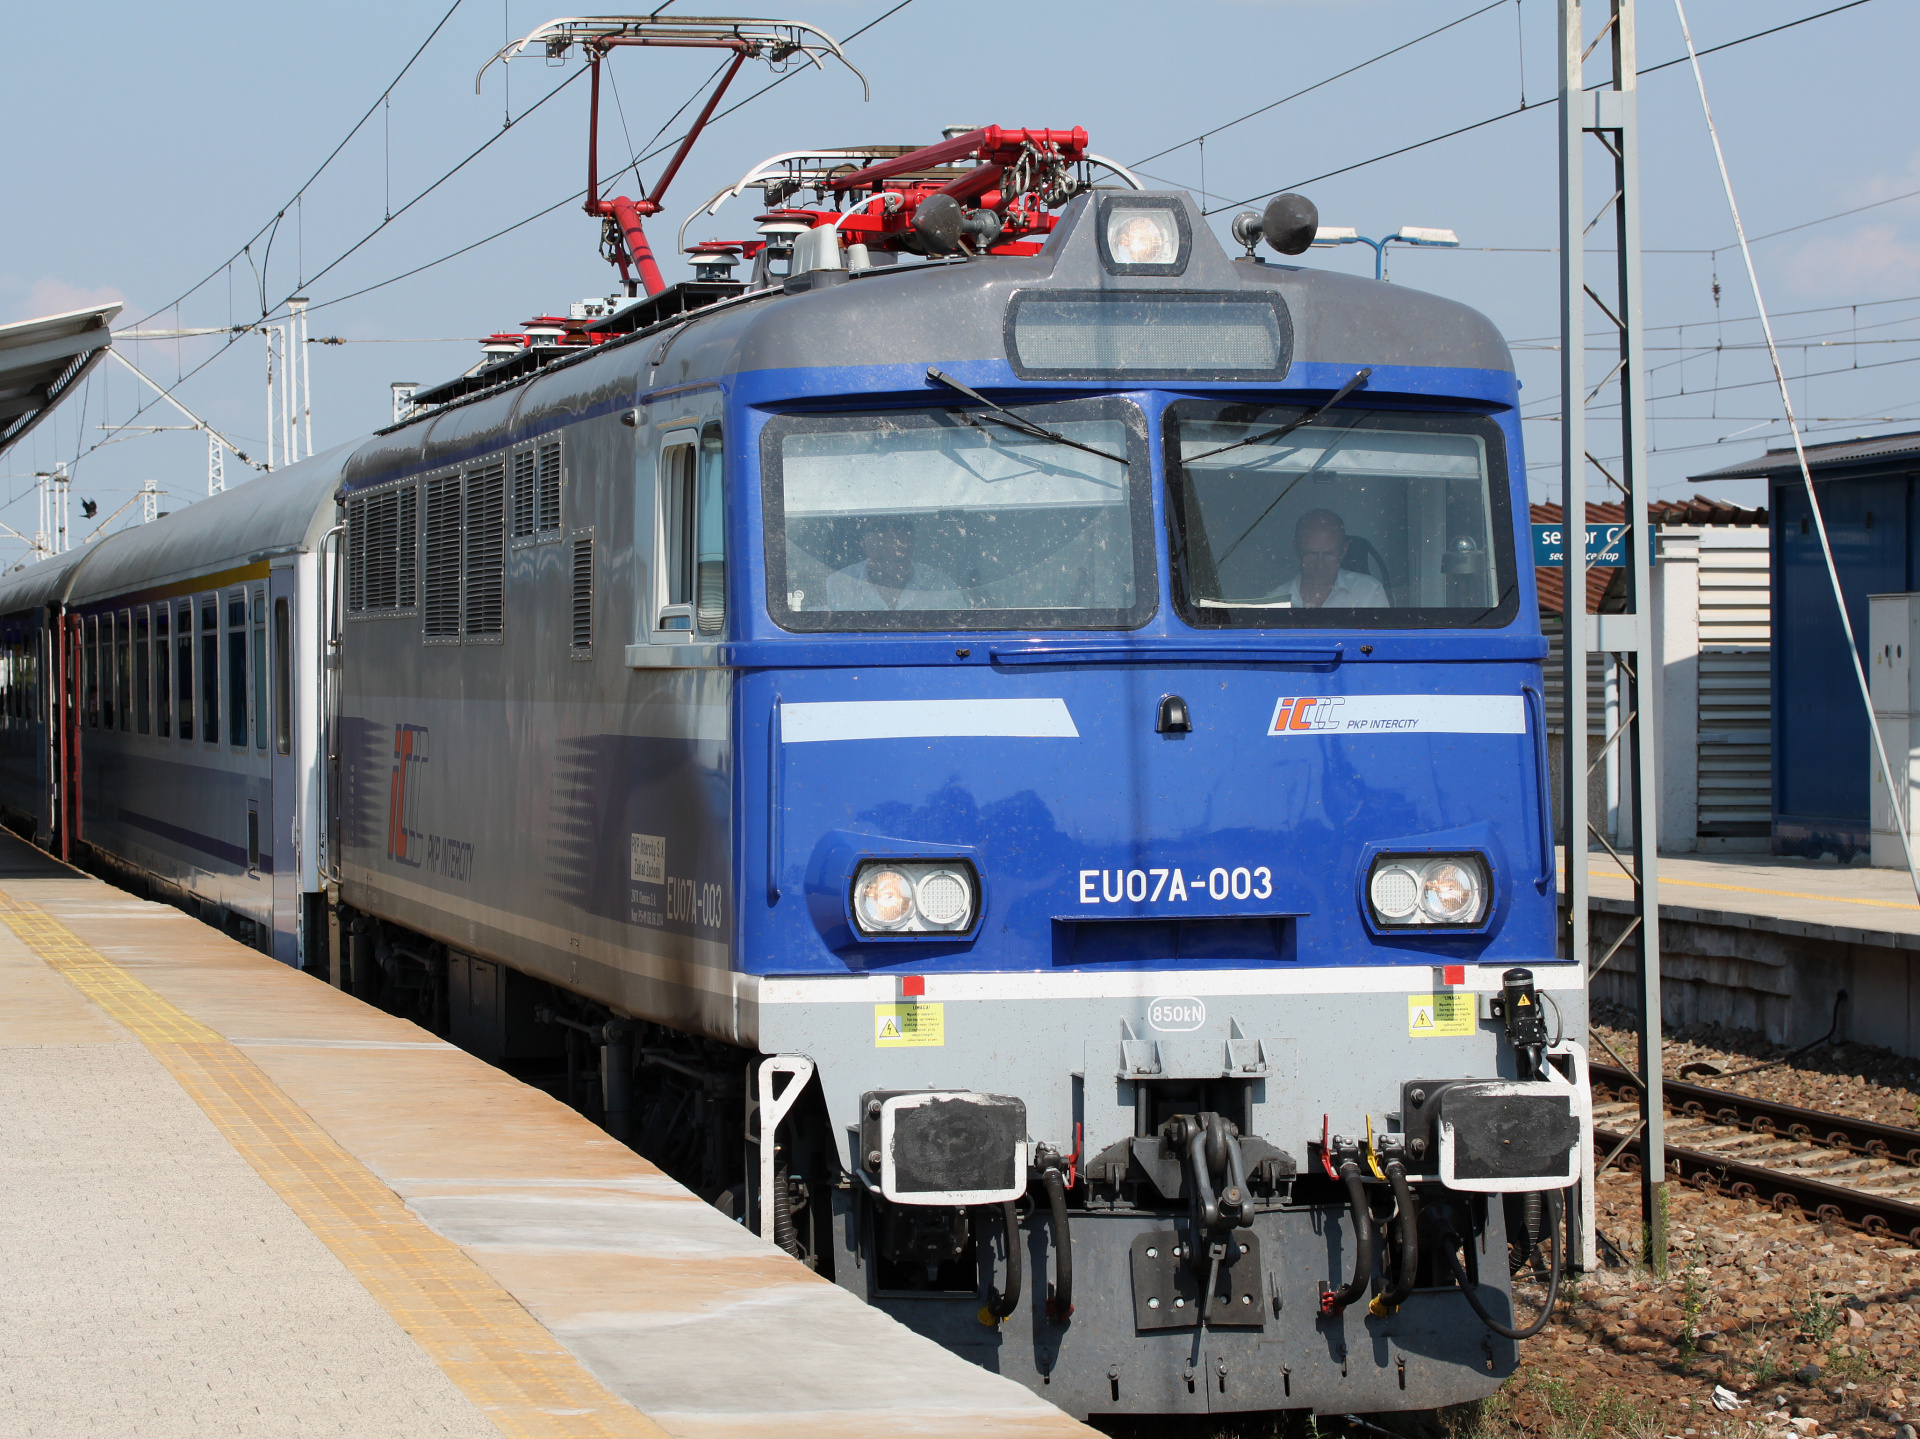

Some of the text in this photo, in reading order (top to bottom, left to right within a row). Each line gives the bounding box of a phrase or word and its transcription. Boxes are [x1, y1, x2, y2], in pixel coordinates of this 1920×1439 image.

[1346, 718, 1420, 730] PKP INTERCITY
[426, 834, 475, 884] PKP INTERCITY
[666, 876, 722, 929] EU07A-003
[1079, 866, 1273, 904] EU07A-003
[1152, 1005, 1203, 1022] 850kN
